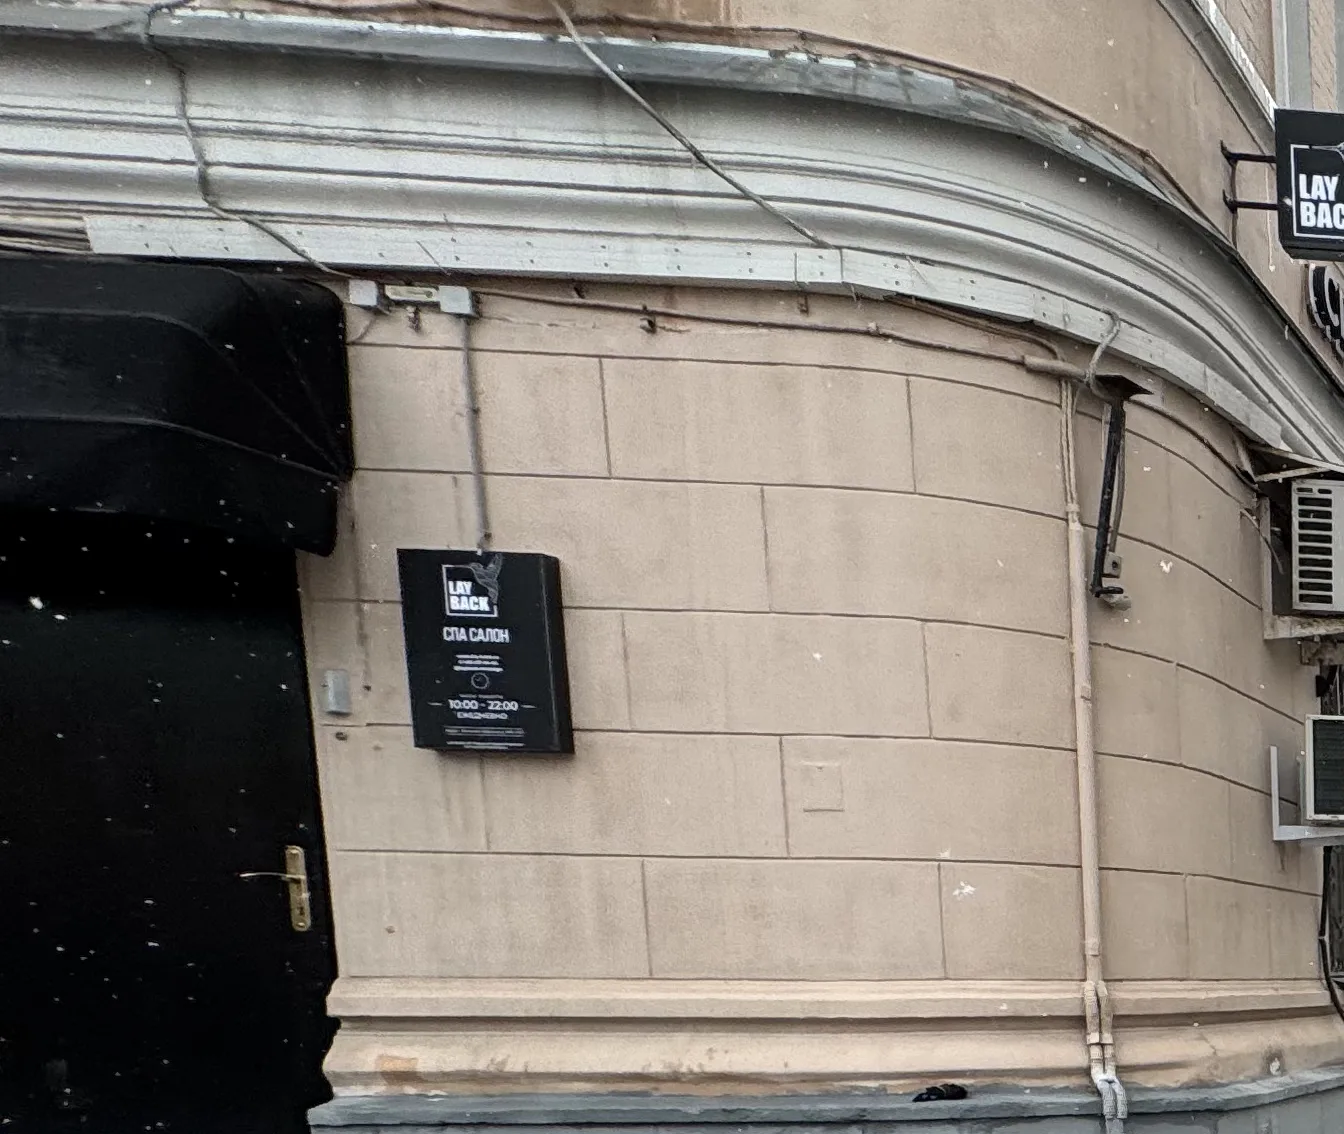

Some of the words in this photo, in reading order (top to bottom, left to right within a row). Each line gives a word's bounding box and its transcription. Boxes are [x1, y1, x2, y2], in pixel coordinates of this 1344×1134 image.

[1299, 173, 1339, 201] LAY
[448, 581, 472, 595] LAY
[450, 596, 491, 611] BACK
[443, 626, 468, 641] СПА
[469, 627, 510, 643] САЛОН
[448, 699, 479, 710] 10:00
[486, 700, 519, 711] 22:00
